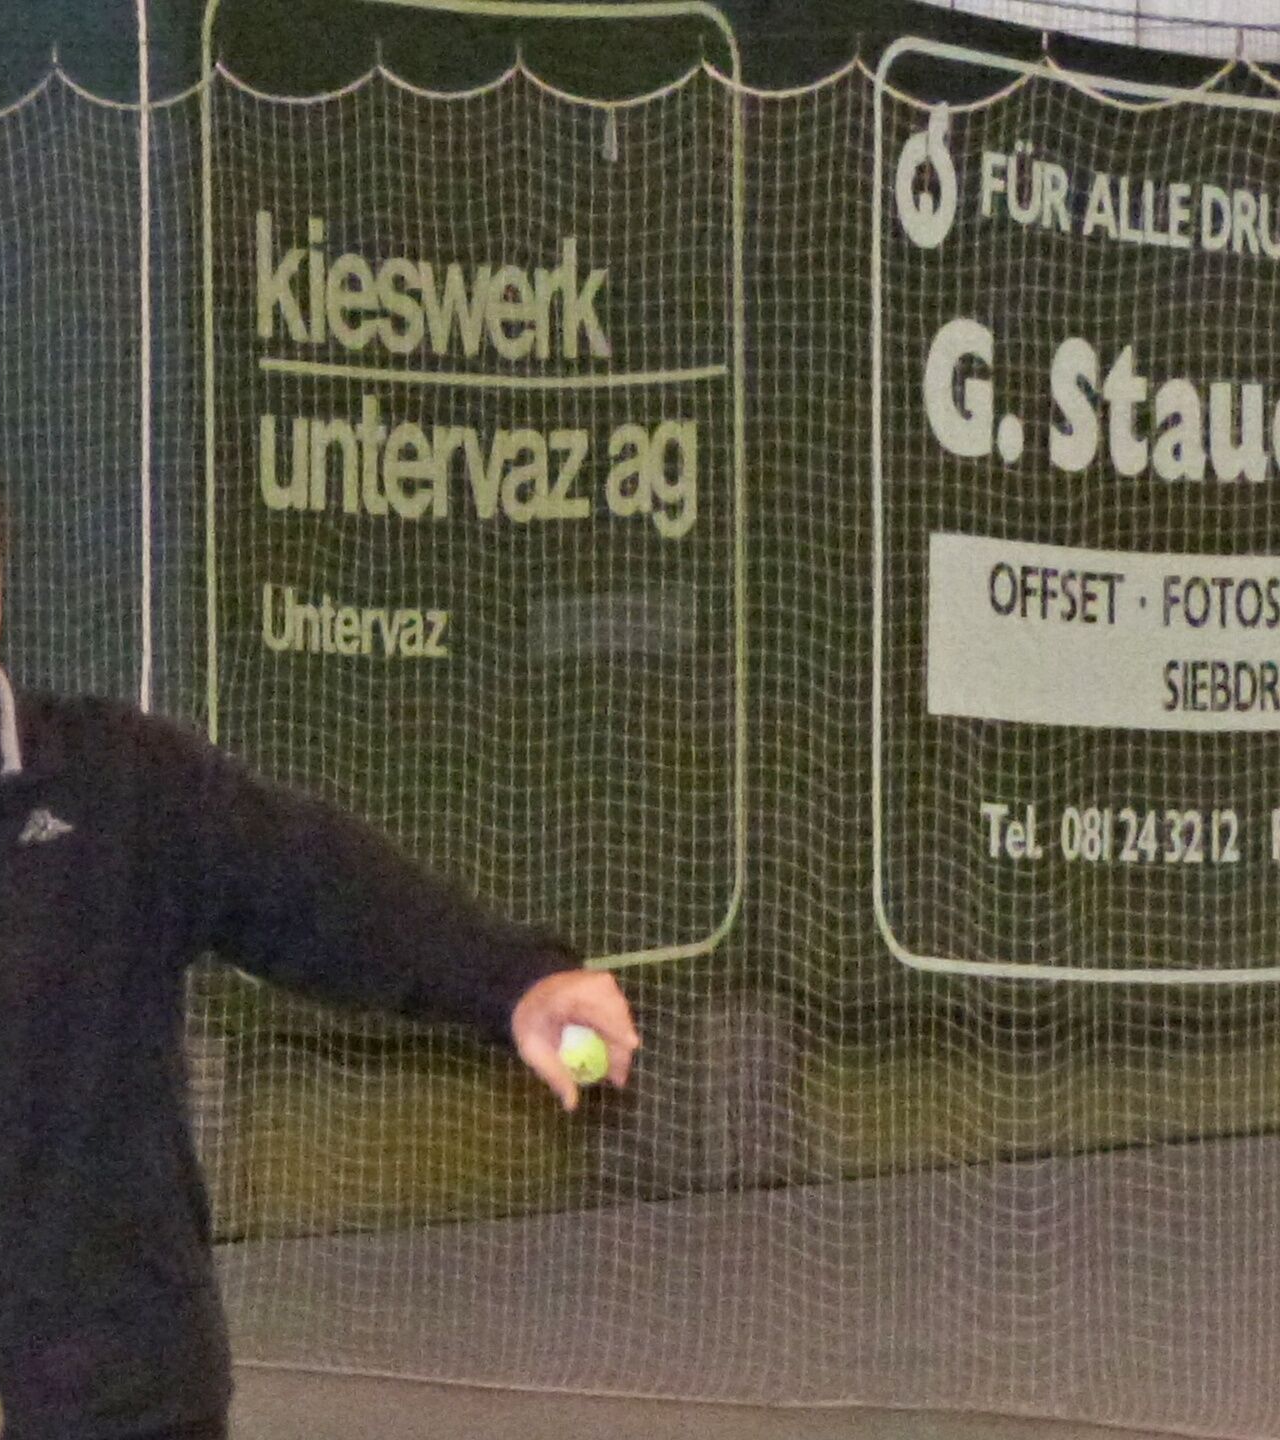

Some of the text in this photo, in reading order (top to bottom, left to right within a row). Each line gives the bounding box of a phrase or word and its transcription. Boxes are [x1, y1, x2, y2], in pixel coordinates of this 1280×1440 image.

[980, 142, 1070, 232] FÜR
[1082, 168, 1190, 250] ALLE
[256, 210, 612, 360] kieswerk
[924, 319, 1023, 464] G.
[260, 394, 698, 538] untervaz ag
[261, 582, 449, 658] Untervaz
[989, 562, 1124, 625] OFFSET
[980, 803, 1043, 859] Tel.
